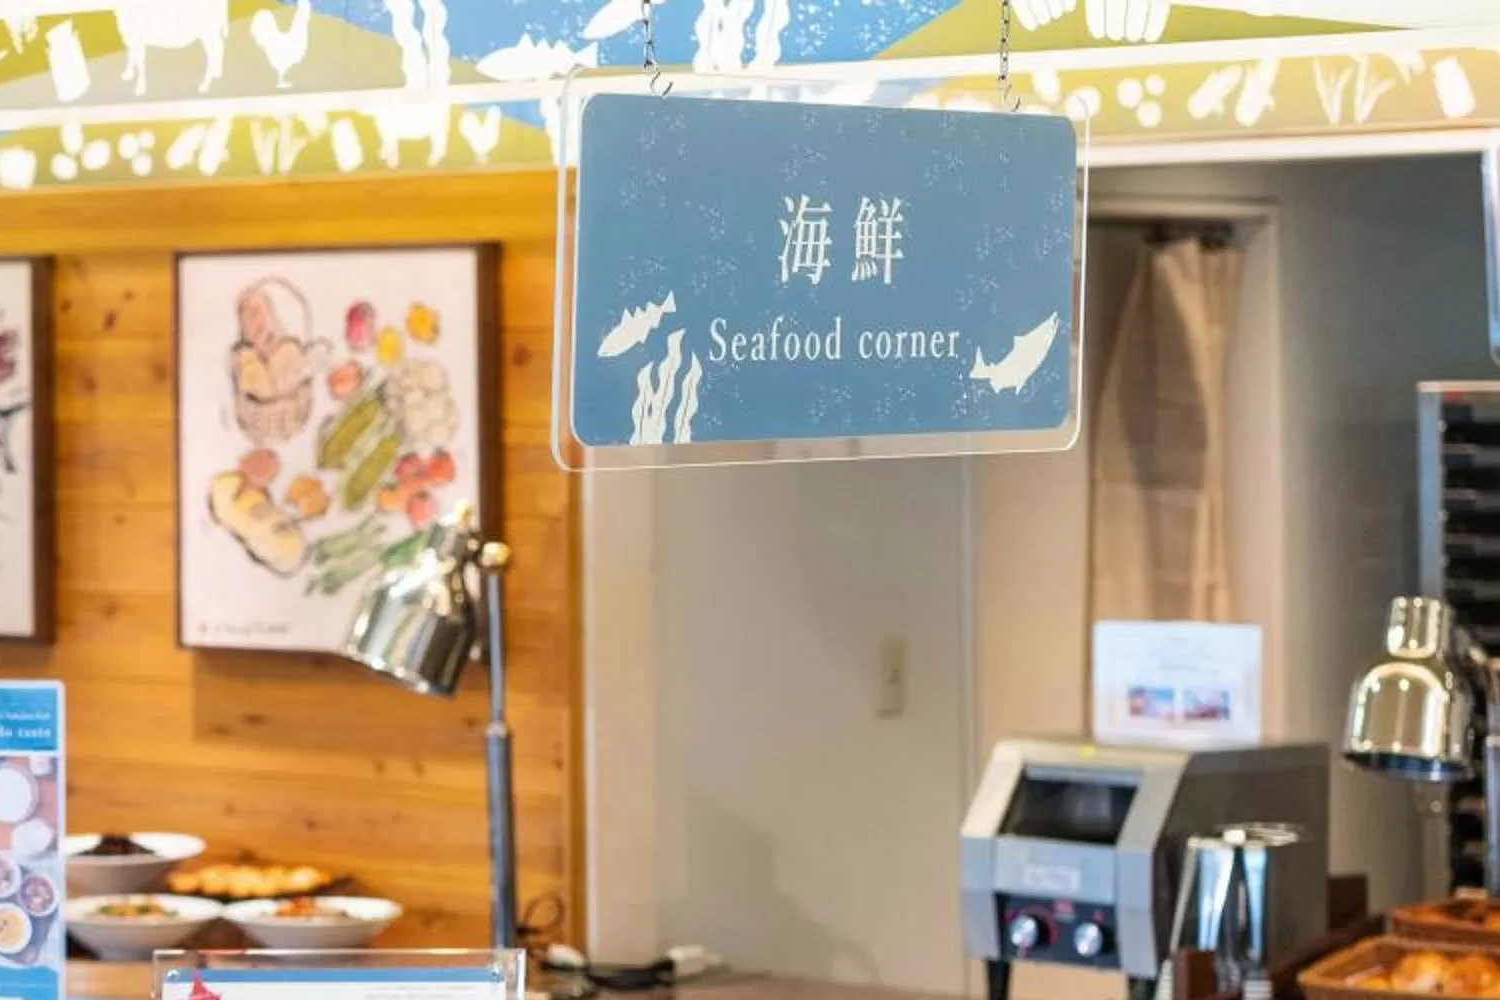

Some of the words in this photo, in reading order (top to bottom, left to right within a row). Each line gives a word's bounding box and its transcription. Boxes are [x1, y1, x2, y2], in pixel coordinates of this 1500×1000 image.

[778, 194, 904, 286] 海鮮
[708, 315, 843, 362] Seafood
[858, 329, 961, 360] corner
